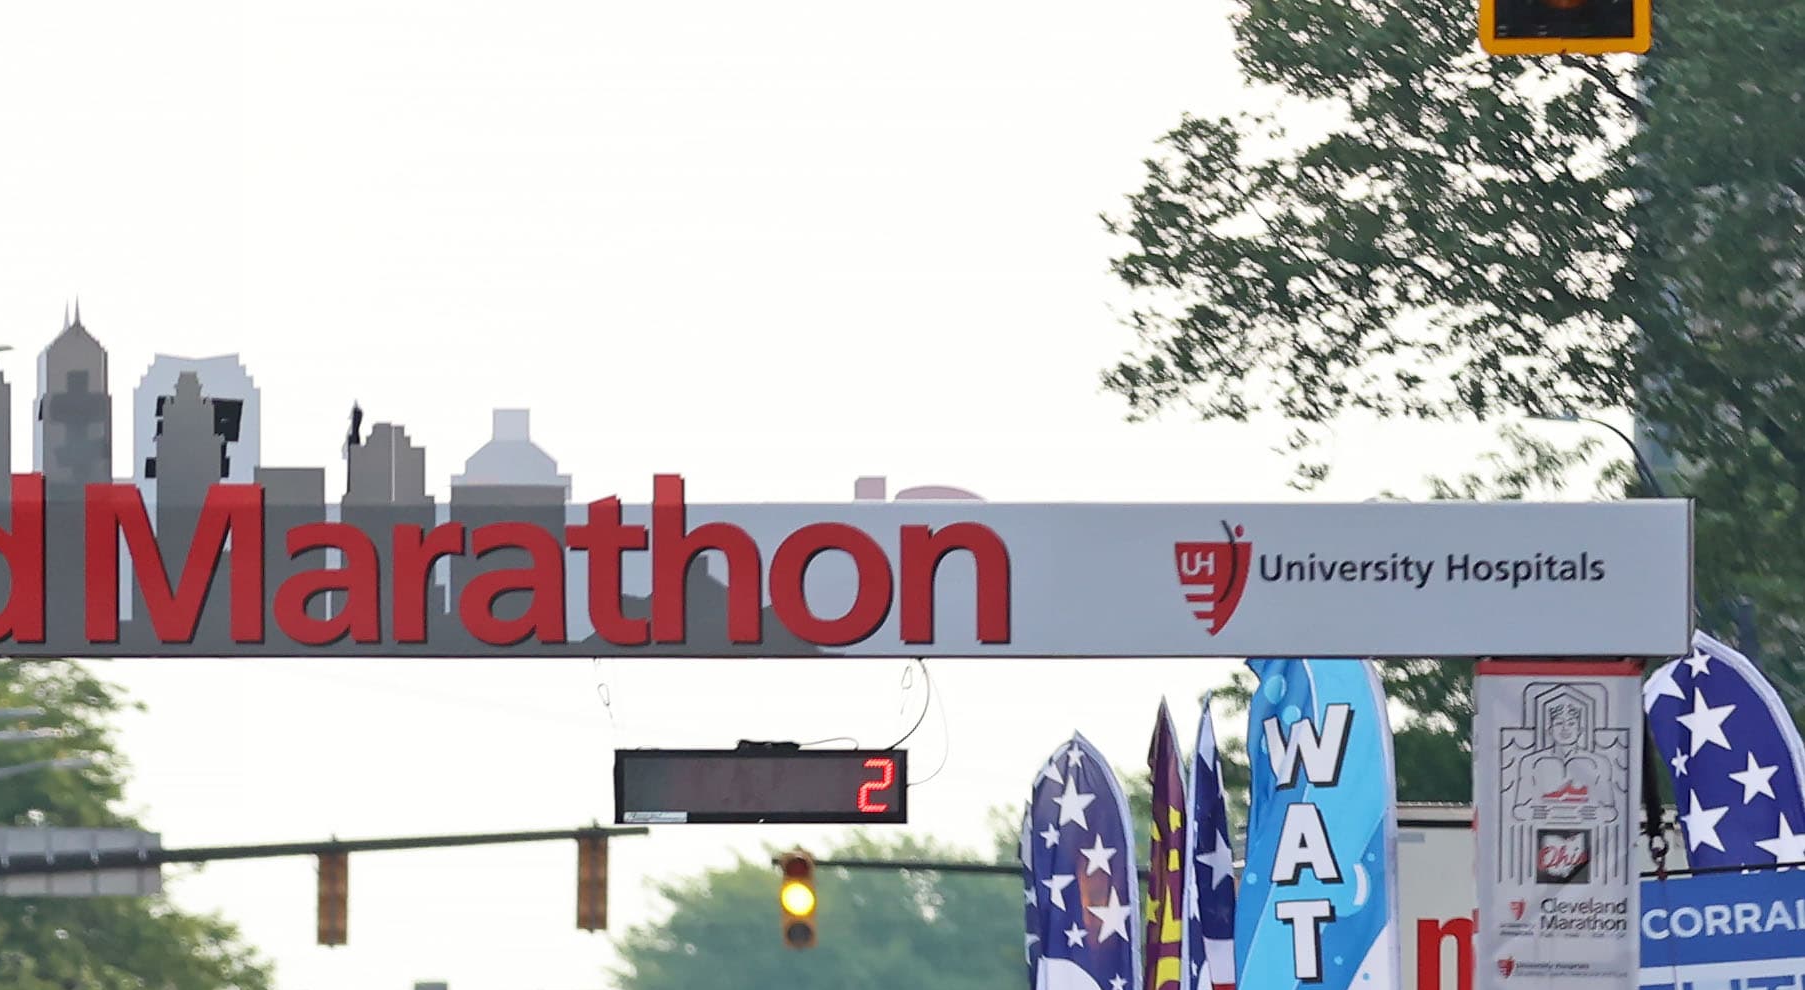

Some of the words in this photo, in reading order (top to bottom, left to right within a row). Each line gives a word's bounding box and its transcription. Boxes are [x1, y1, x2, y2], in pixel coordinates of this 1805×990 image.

[84, 473, 1011, 646] Marathon
[1259, 552, 1435, 589] University
[1447, 552, 1605, 588] Hospitals
[857, 758, 894, 813] 2
[1540, 898, 1627, 914] Cleveland
[1540, 915, 1627, 930] Marathon
